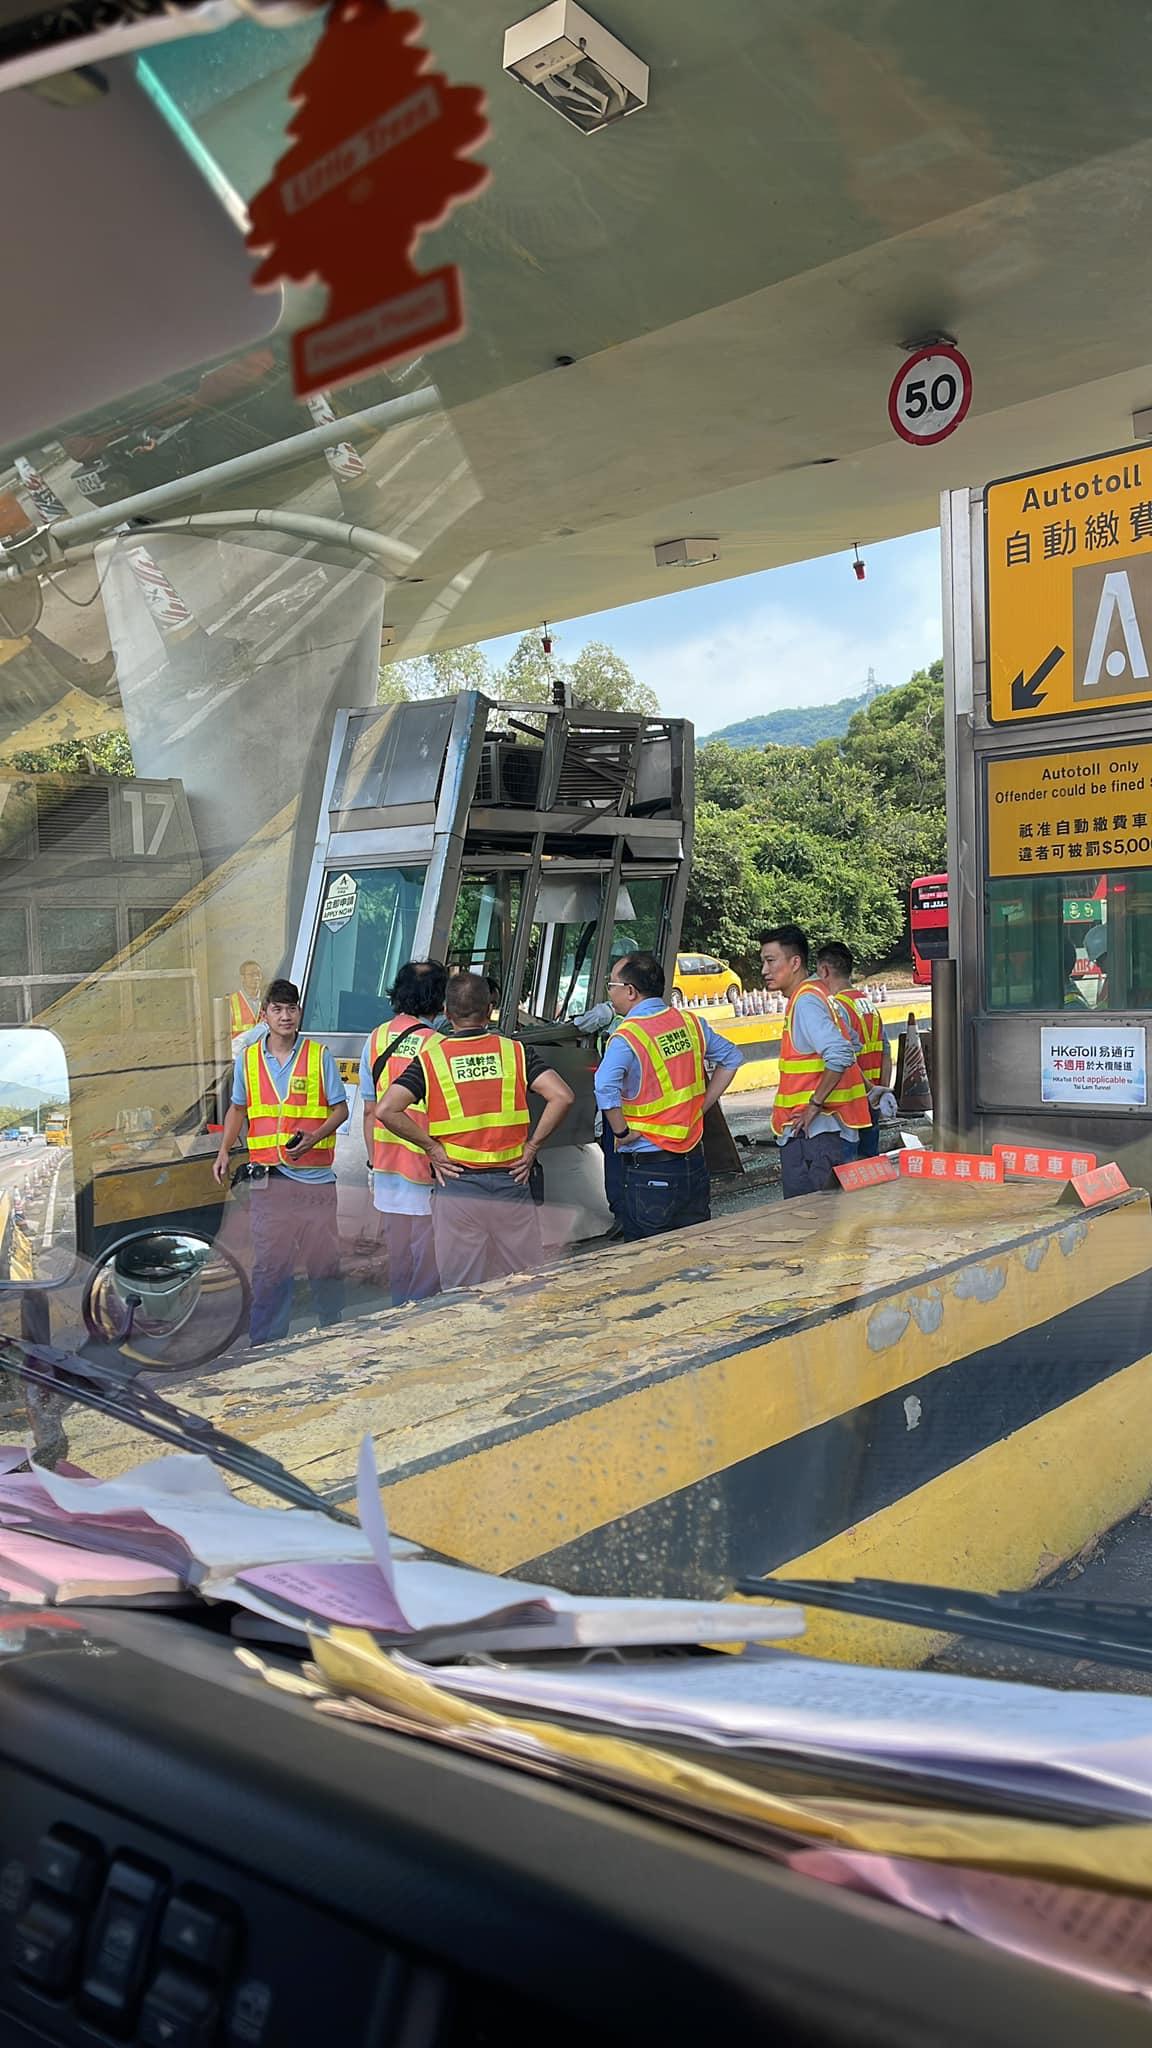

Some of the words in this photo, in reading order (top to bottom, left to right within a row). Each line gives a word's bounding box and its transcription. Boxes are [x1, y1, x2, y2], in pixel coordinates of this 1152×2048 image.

[905, 374, 956, 418] 50
[1022, 464, 1142, 513] Autotoll
[1042, 763, 1100, 781] Autotoll
[1109, 761, 1139, 773] Only
[995, 789, 1047, 804] Offender
[1052, 784, 1086, 799] could
[1091, 782, 1107, 795] be
[1112, 778, 1145, 793] fined
[123, 791, 178, 855] 17
[663, 1039, 691, 1057] R3CPS
[1051, 1046, 1097, 1057] HKeToll
[1099, 1046, 1135, 1058] 易通行
[457, 1065, 498, 1079] R3CPS
[1086, 1076, 1126, 1085] applicable
